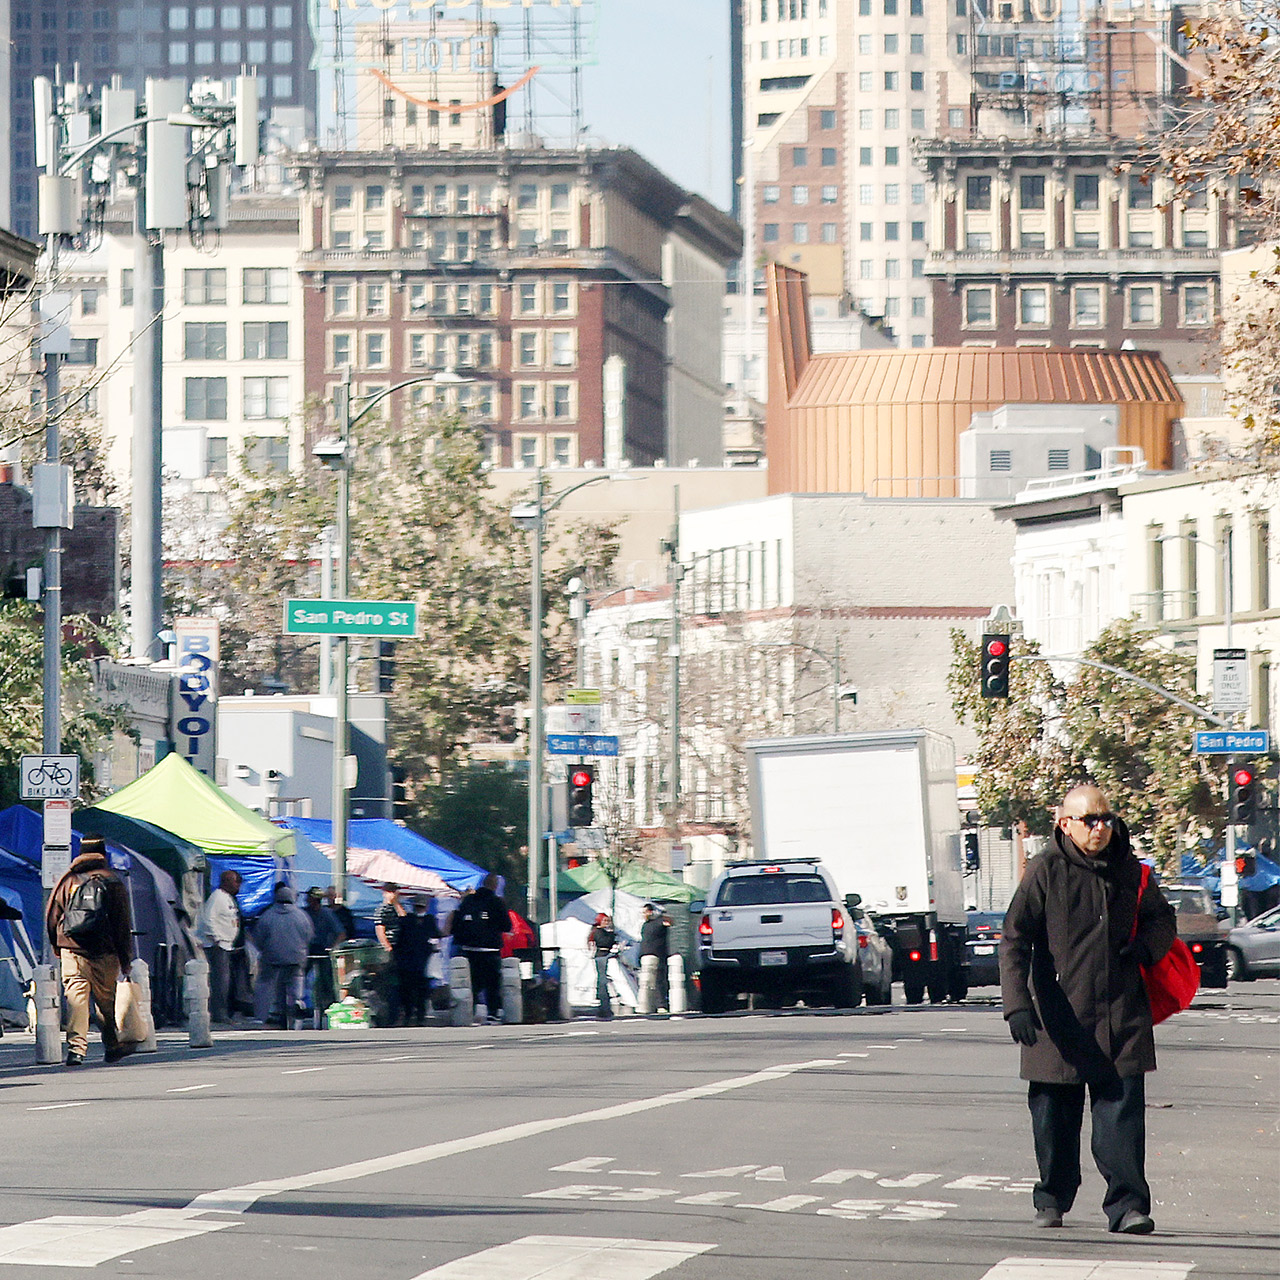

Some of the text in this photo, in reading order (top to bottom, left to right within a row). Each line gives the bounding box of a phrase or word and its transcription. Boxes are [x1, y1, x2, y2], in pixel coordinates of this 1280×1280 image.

[401, 35, 509, 73] HOTEL
[293, 608, 410, 626] San Pedro St
[1222, 673, 1240, 682] BUS
[1220, 682, 1241, 690] ONLY
[551, 738, 576, 751] San
[1199, 734, 1264, 748] San Pedro
[27, 787, 47, 797] BIKE
[548, 1156, 1040, 1194] LANE
[522, 1184, 960, 1222] BUS
